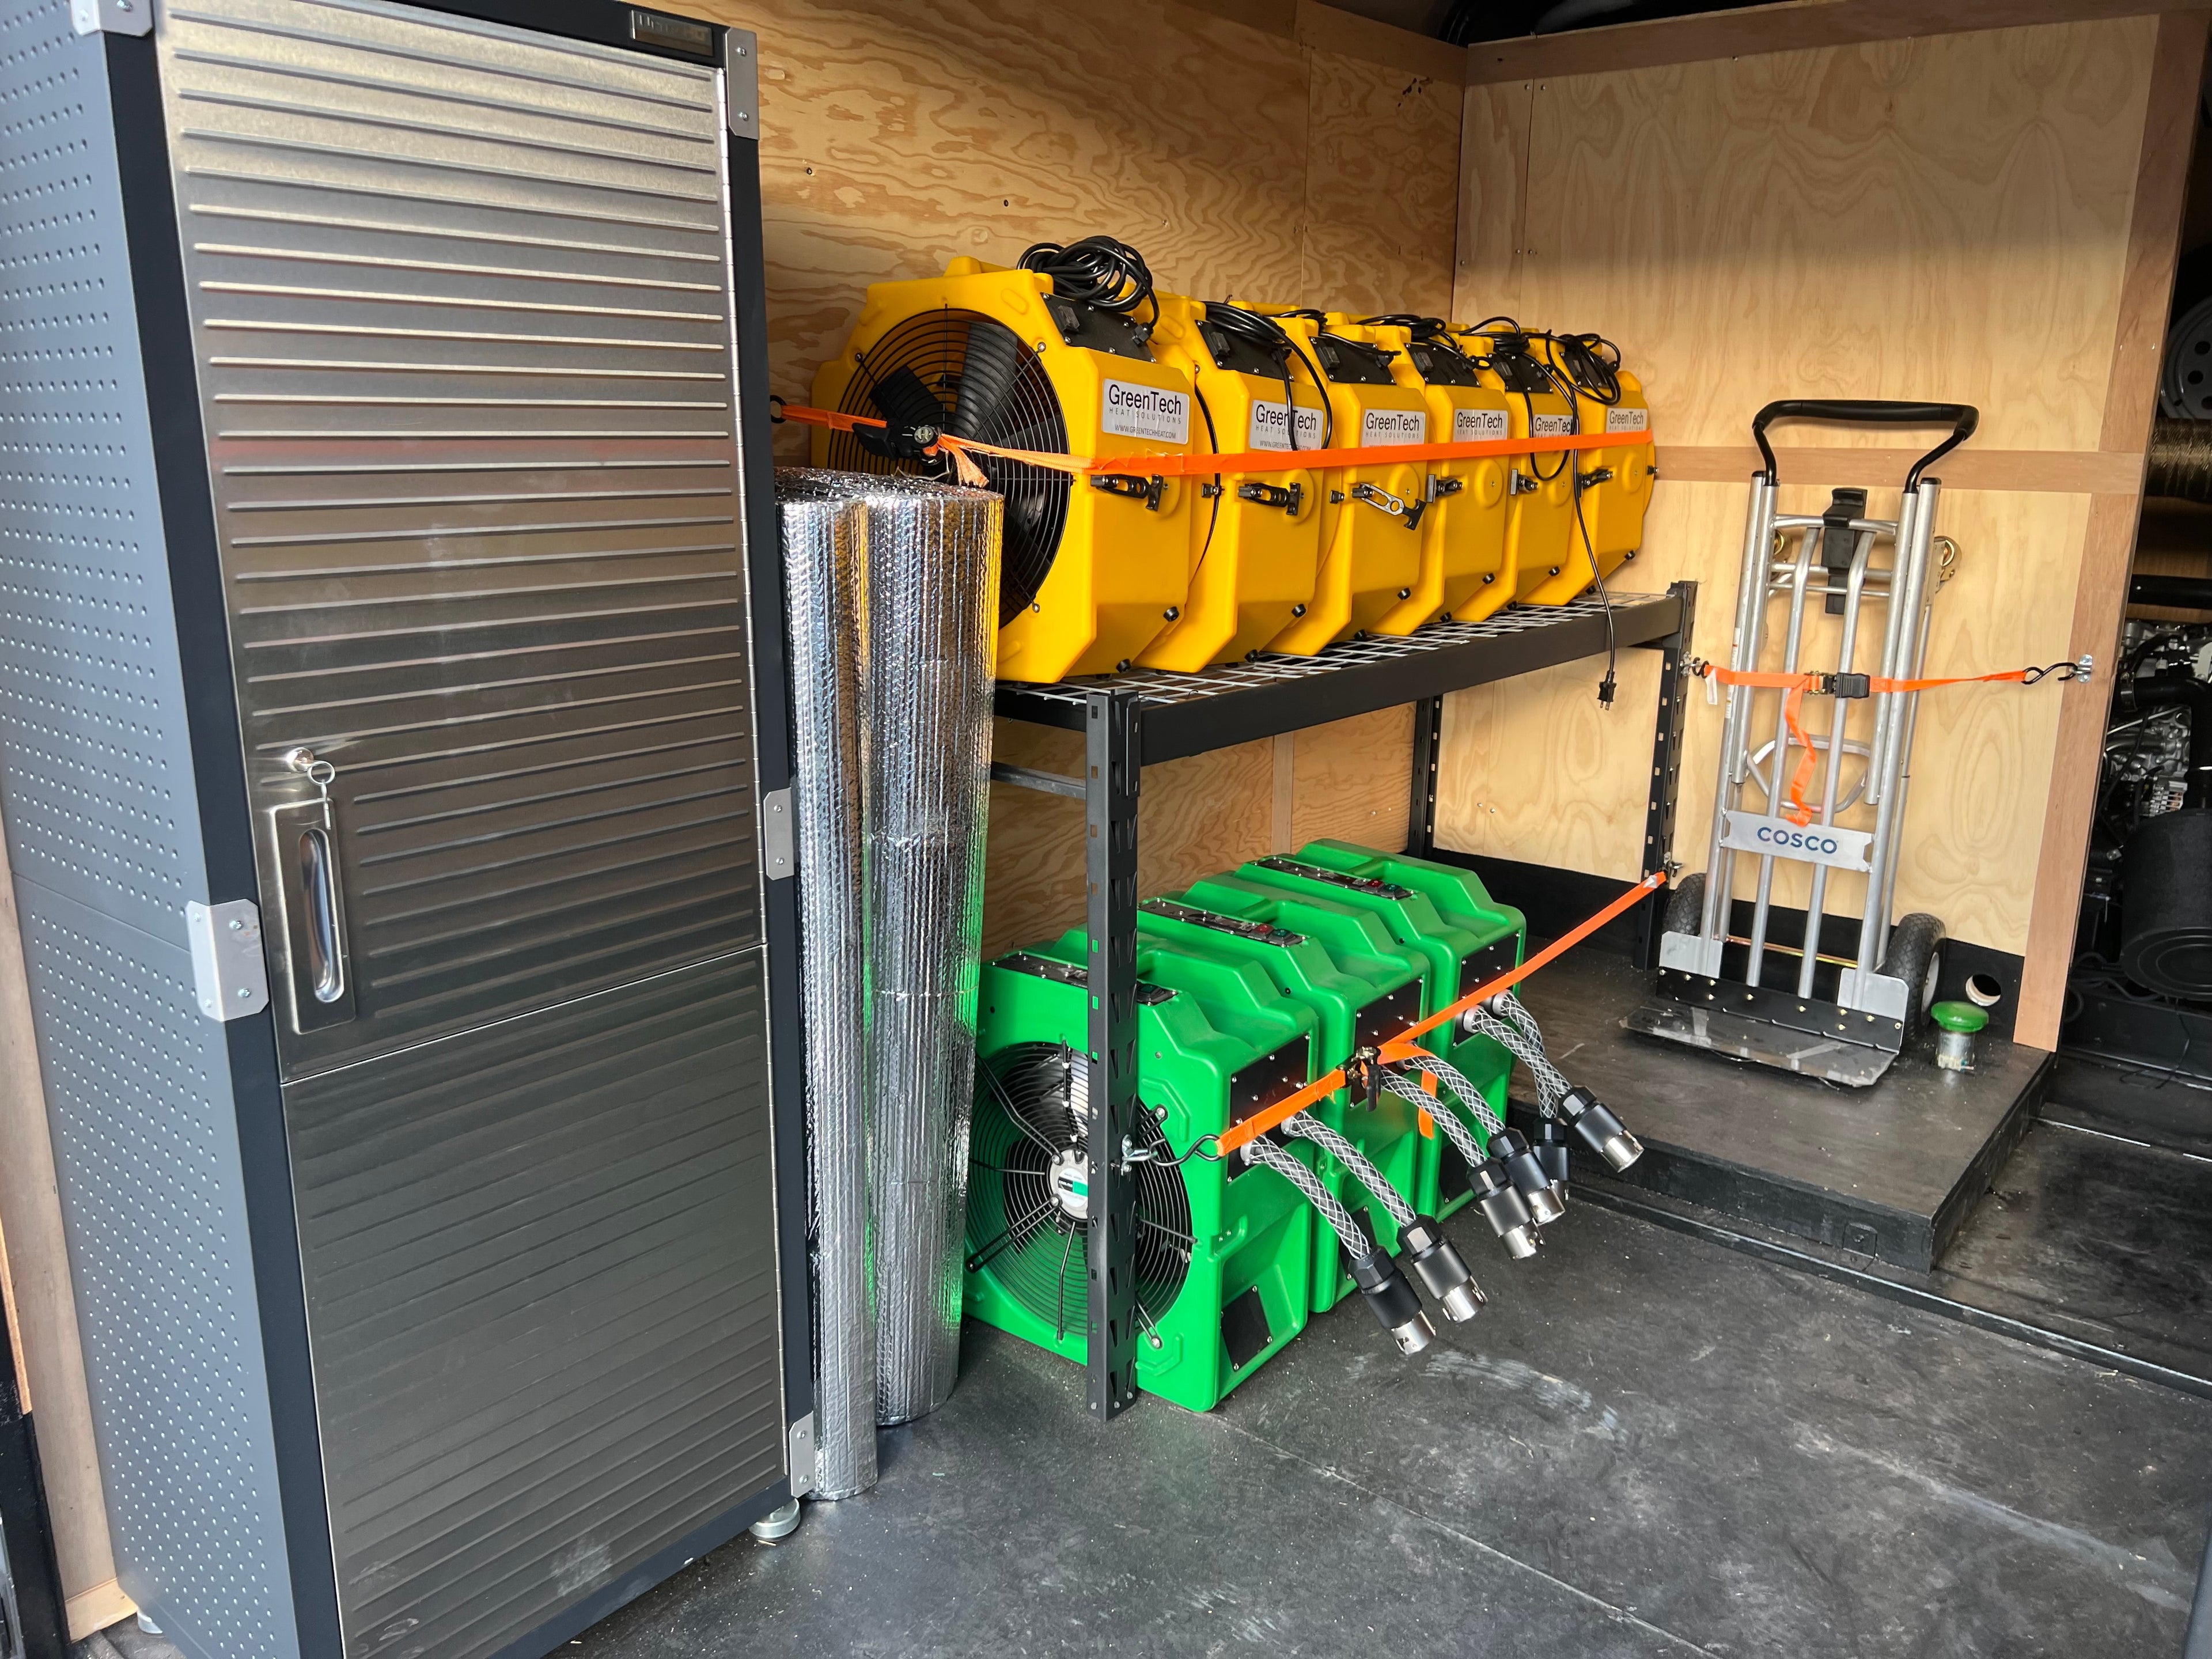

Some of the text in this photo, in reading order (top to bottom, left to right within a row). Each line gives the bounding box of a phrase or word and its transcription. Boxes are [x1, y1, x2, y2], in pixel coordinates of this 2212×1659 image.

[1109, 384, 1181, 415] GreenTech
[1109, 407, 1181, 424] HEAT SOLUTIONS
[1256, 404, 1316, 430] GreenTech
[1366, 412, 1419, 431] GreenTech
[1457, 412, 1502, 429] GreenTech
[1609, 410, 1643, 425] GreenTech
[1115, 425, 1176, 438] WWW.GREENTECHHEAT.COM
[1757, 827, 1837, 854] COSCO
